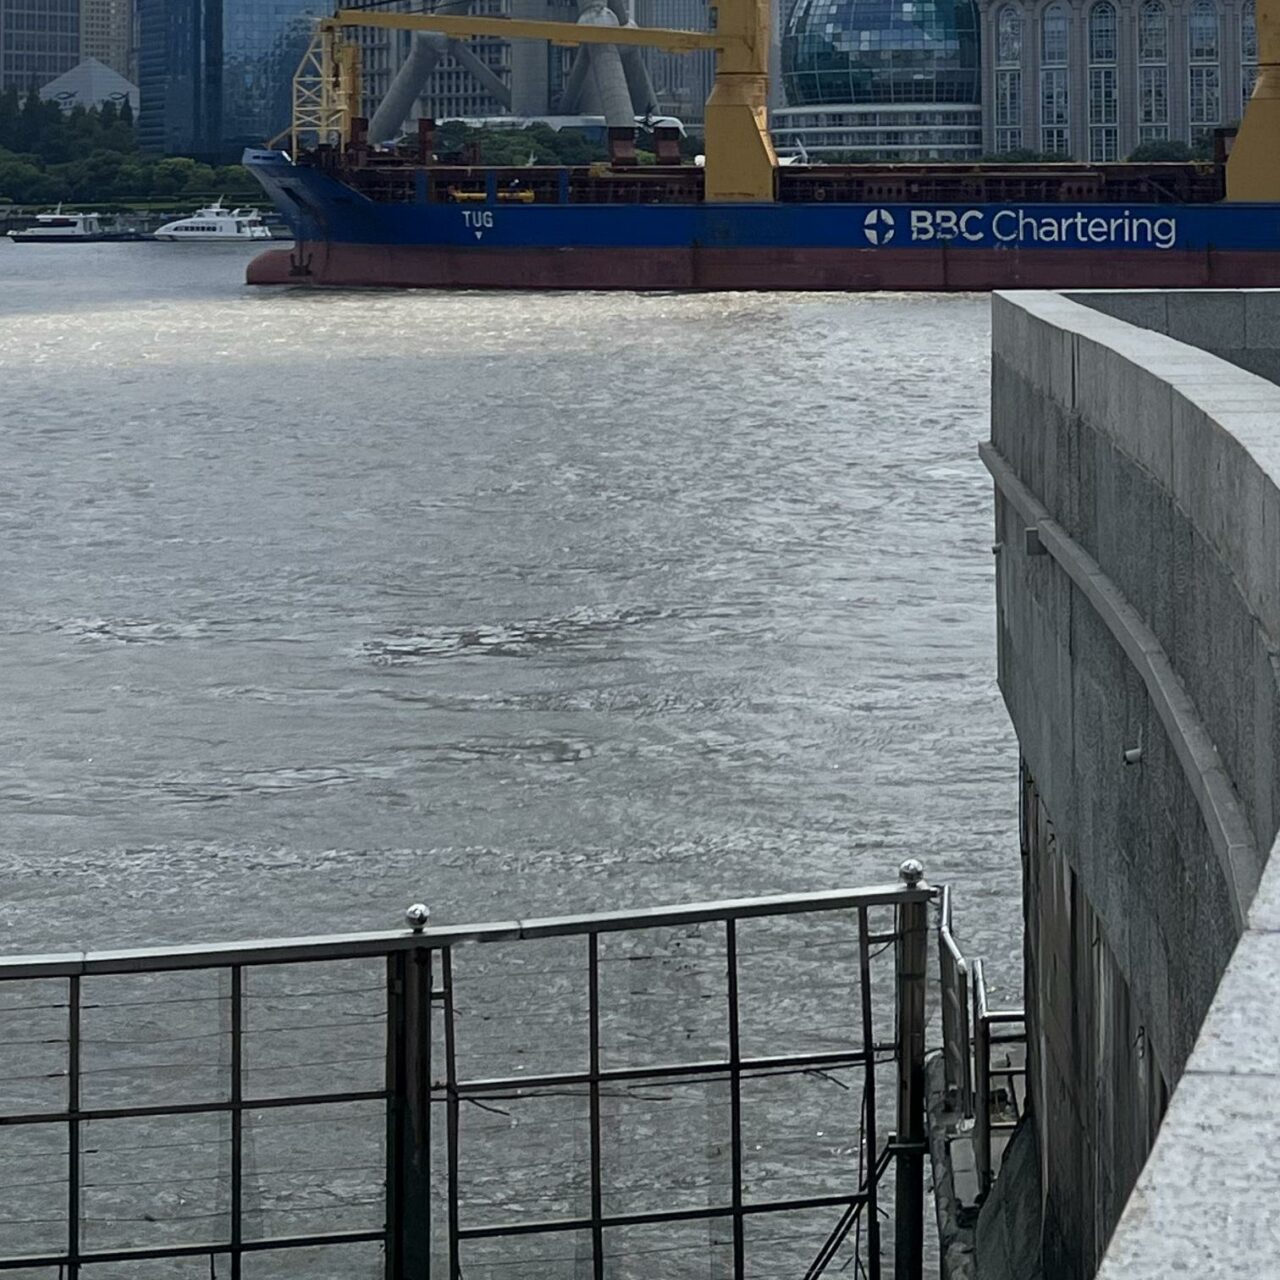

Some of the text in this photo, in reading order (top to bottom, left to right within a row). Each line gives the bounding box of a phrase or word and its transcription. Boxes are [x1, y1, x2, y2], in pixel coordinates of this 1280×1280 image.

[461, 211, 494, 228] TUG
[910, 209, 1176, 249] BBC Chartering
